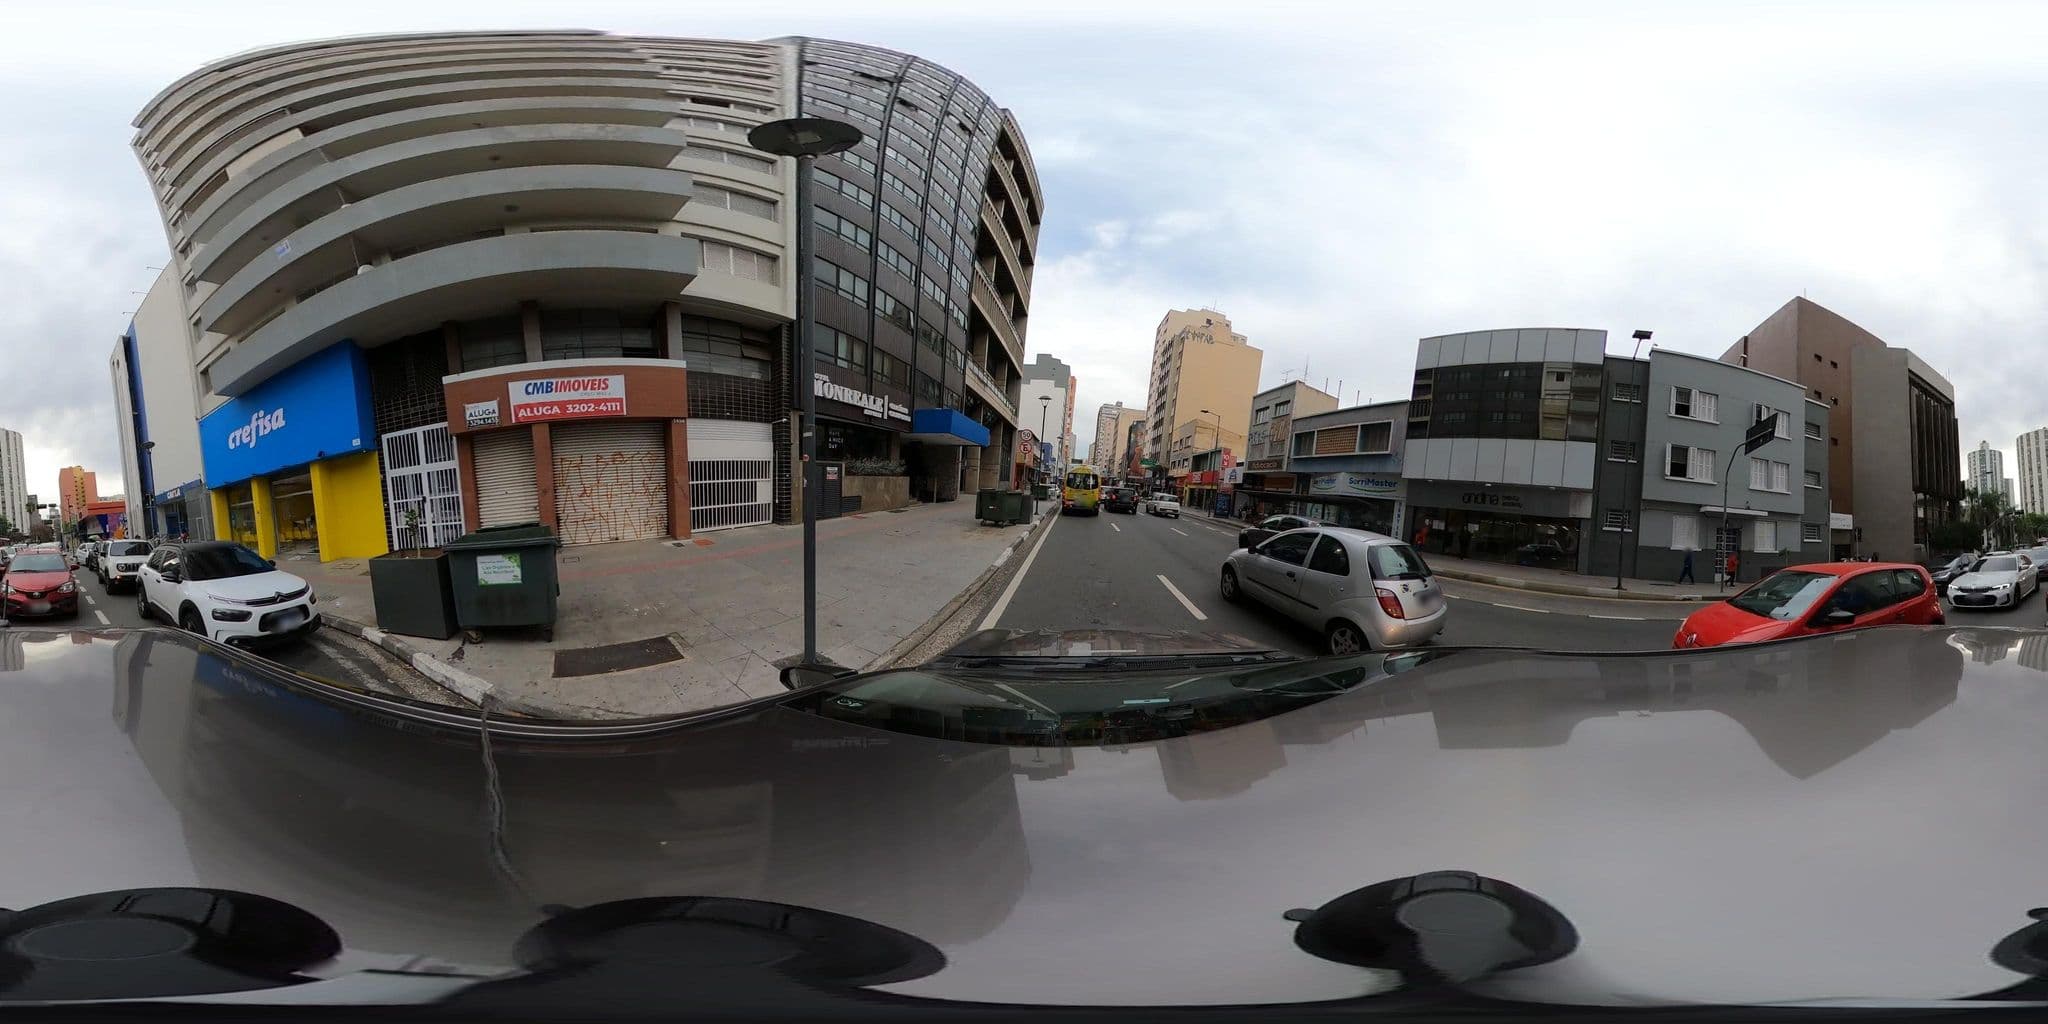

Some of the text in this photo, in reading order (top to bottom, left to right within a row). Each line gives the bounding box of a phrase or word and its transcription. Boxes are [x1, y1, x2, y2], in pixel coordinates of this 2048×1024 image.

[468, 408, 497, 419] ALUGA
[518, 402, 620, 418] ALUGA 3202-4111
[228, 408, 286, 449] crefisa
